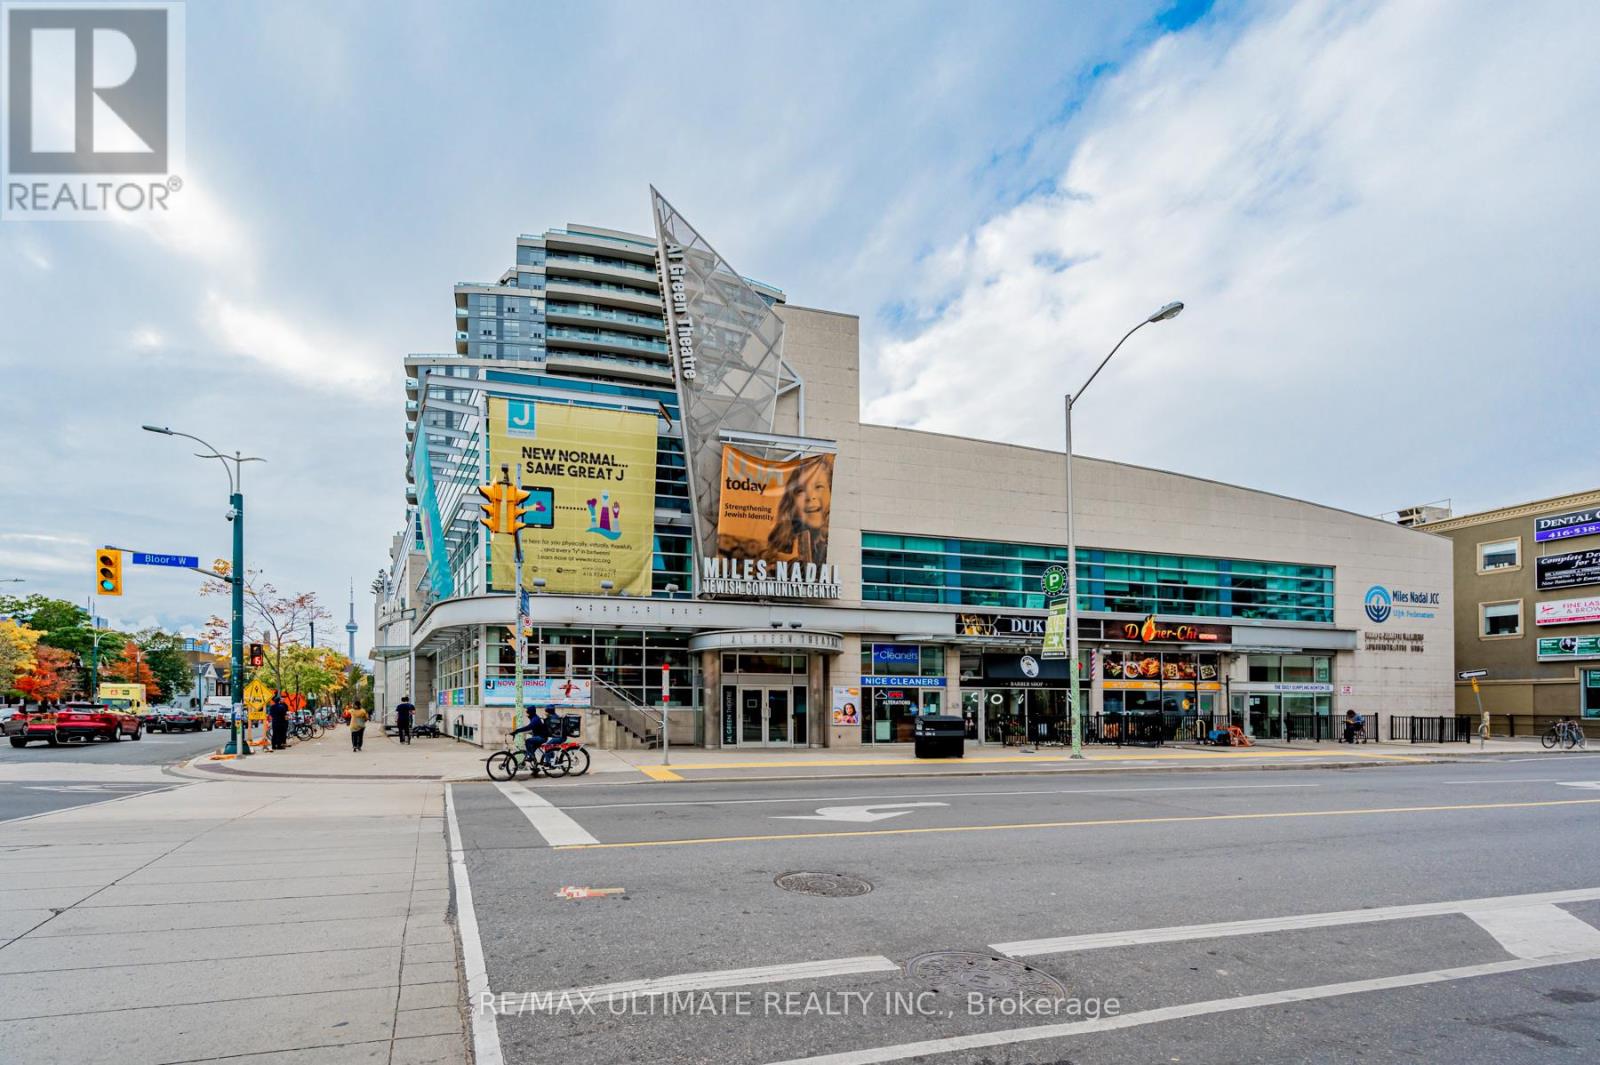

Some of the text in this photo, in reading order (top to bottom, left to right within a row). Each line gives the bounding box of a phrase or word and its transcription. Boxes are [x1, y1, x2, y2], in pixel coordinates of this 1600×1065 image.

[666, 243, 683, 260] Al
[669, 263, 687, 313] Green
[676, 317, 697, 380] Theatre
[512, 403, 530, 426] J
[522, 446, 629, 468] NEW NORMAL...
[526, 461, 625, 481] SAME GREAT J
[725, 476, 767, 495] today
[724, 502, 772, 514] Strengthening
[724, 511, 774, 521] Jewish Identity
[1540, 513, 1592, 529] DENTAL
[145, 554, 170, 564] Bloor
[178, 557, 187, 565] W
[1541, 554, 1583, 565] Complete
[1571, 560, 1589, 569] for
[703, 557, 842, 584] MILES NADAL
[1050, 574, 1059, 587] P
[703, 579, 841, 599] JEWISH COMMUNITY CENTRE
[1393, 590, 1440, 604] Miles Nadal JCC
[1011, 619, 1043, 633] DUK
[879, 650, 918, 660] Cleaners
[865, 677, 939, 686] NICE CLEANERS
